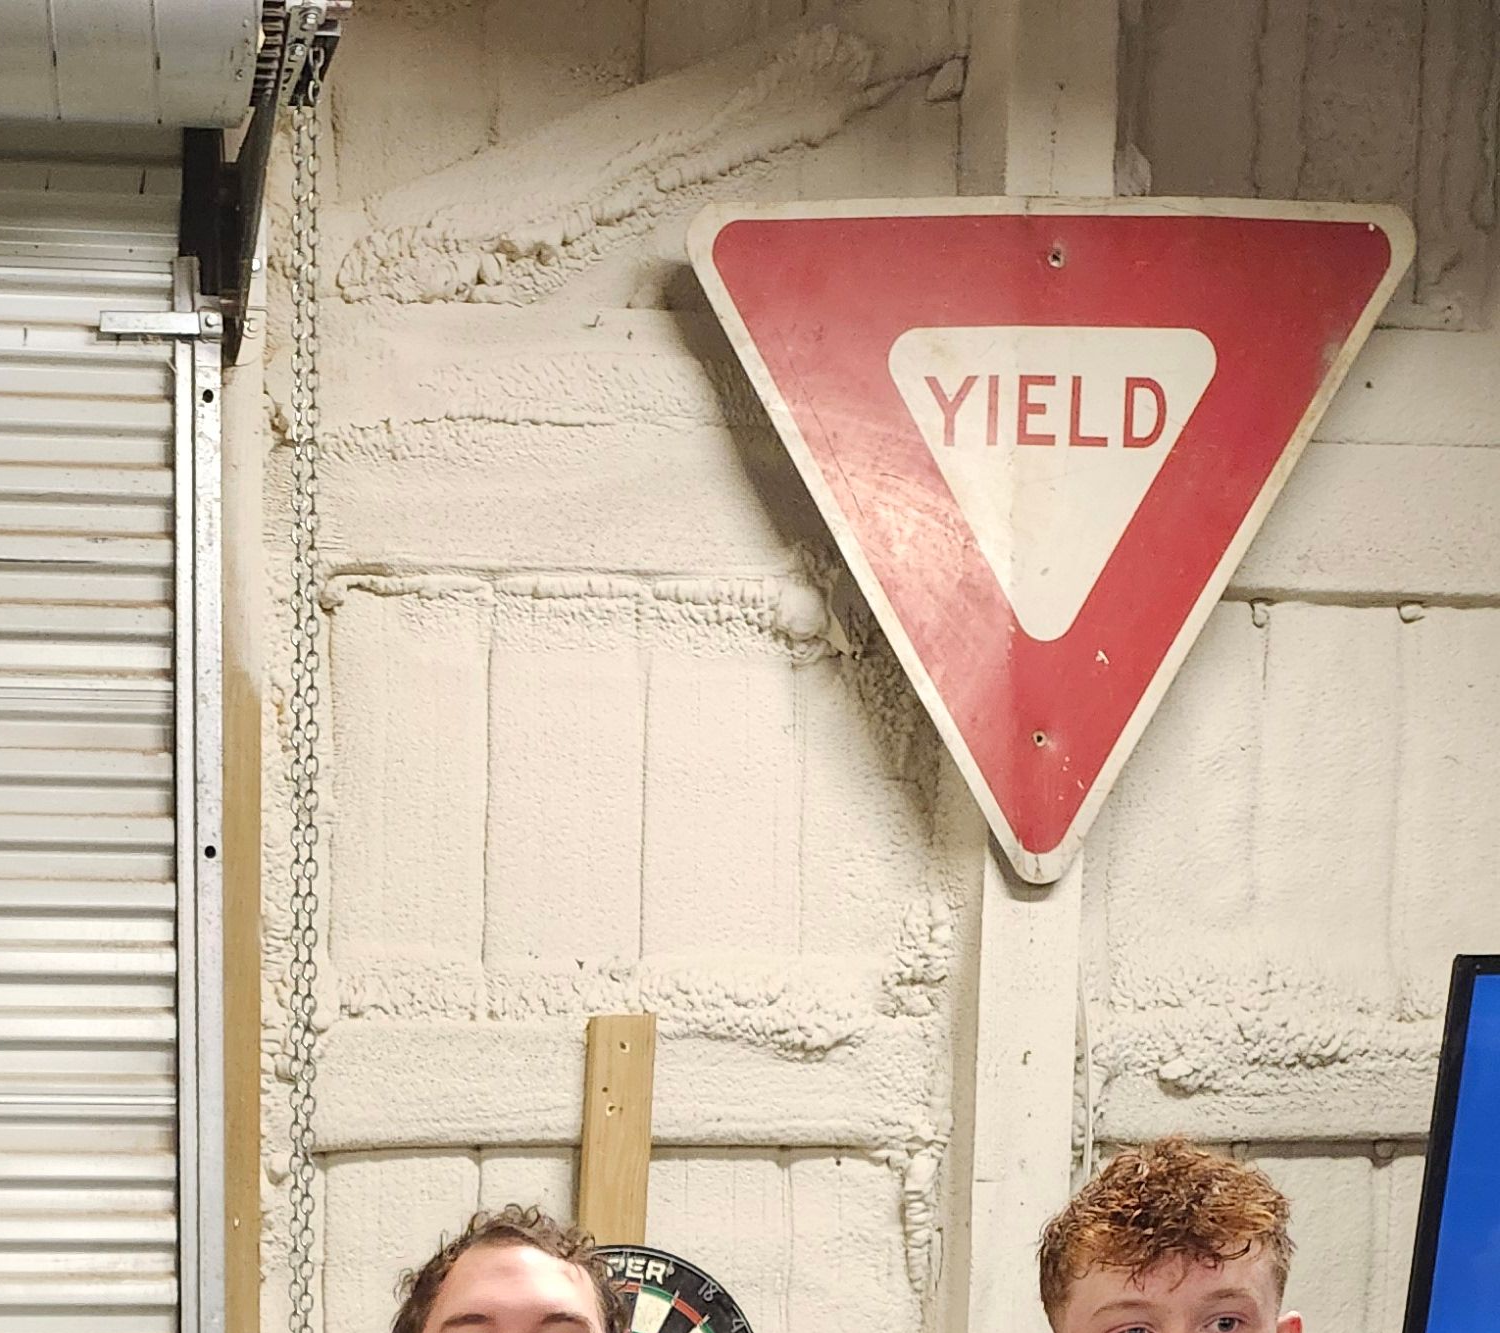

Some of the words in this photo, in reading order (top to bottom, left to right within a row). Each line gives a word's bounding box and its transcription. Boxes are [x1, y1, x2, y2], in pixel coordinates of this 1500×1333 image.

[924, 374, 1167, 448] YIELD
[605, 1256, 666, 1285] PER
[697, 1281, 719, 1302] 18
[730, 1318, 746, 1333] 4
